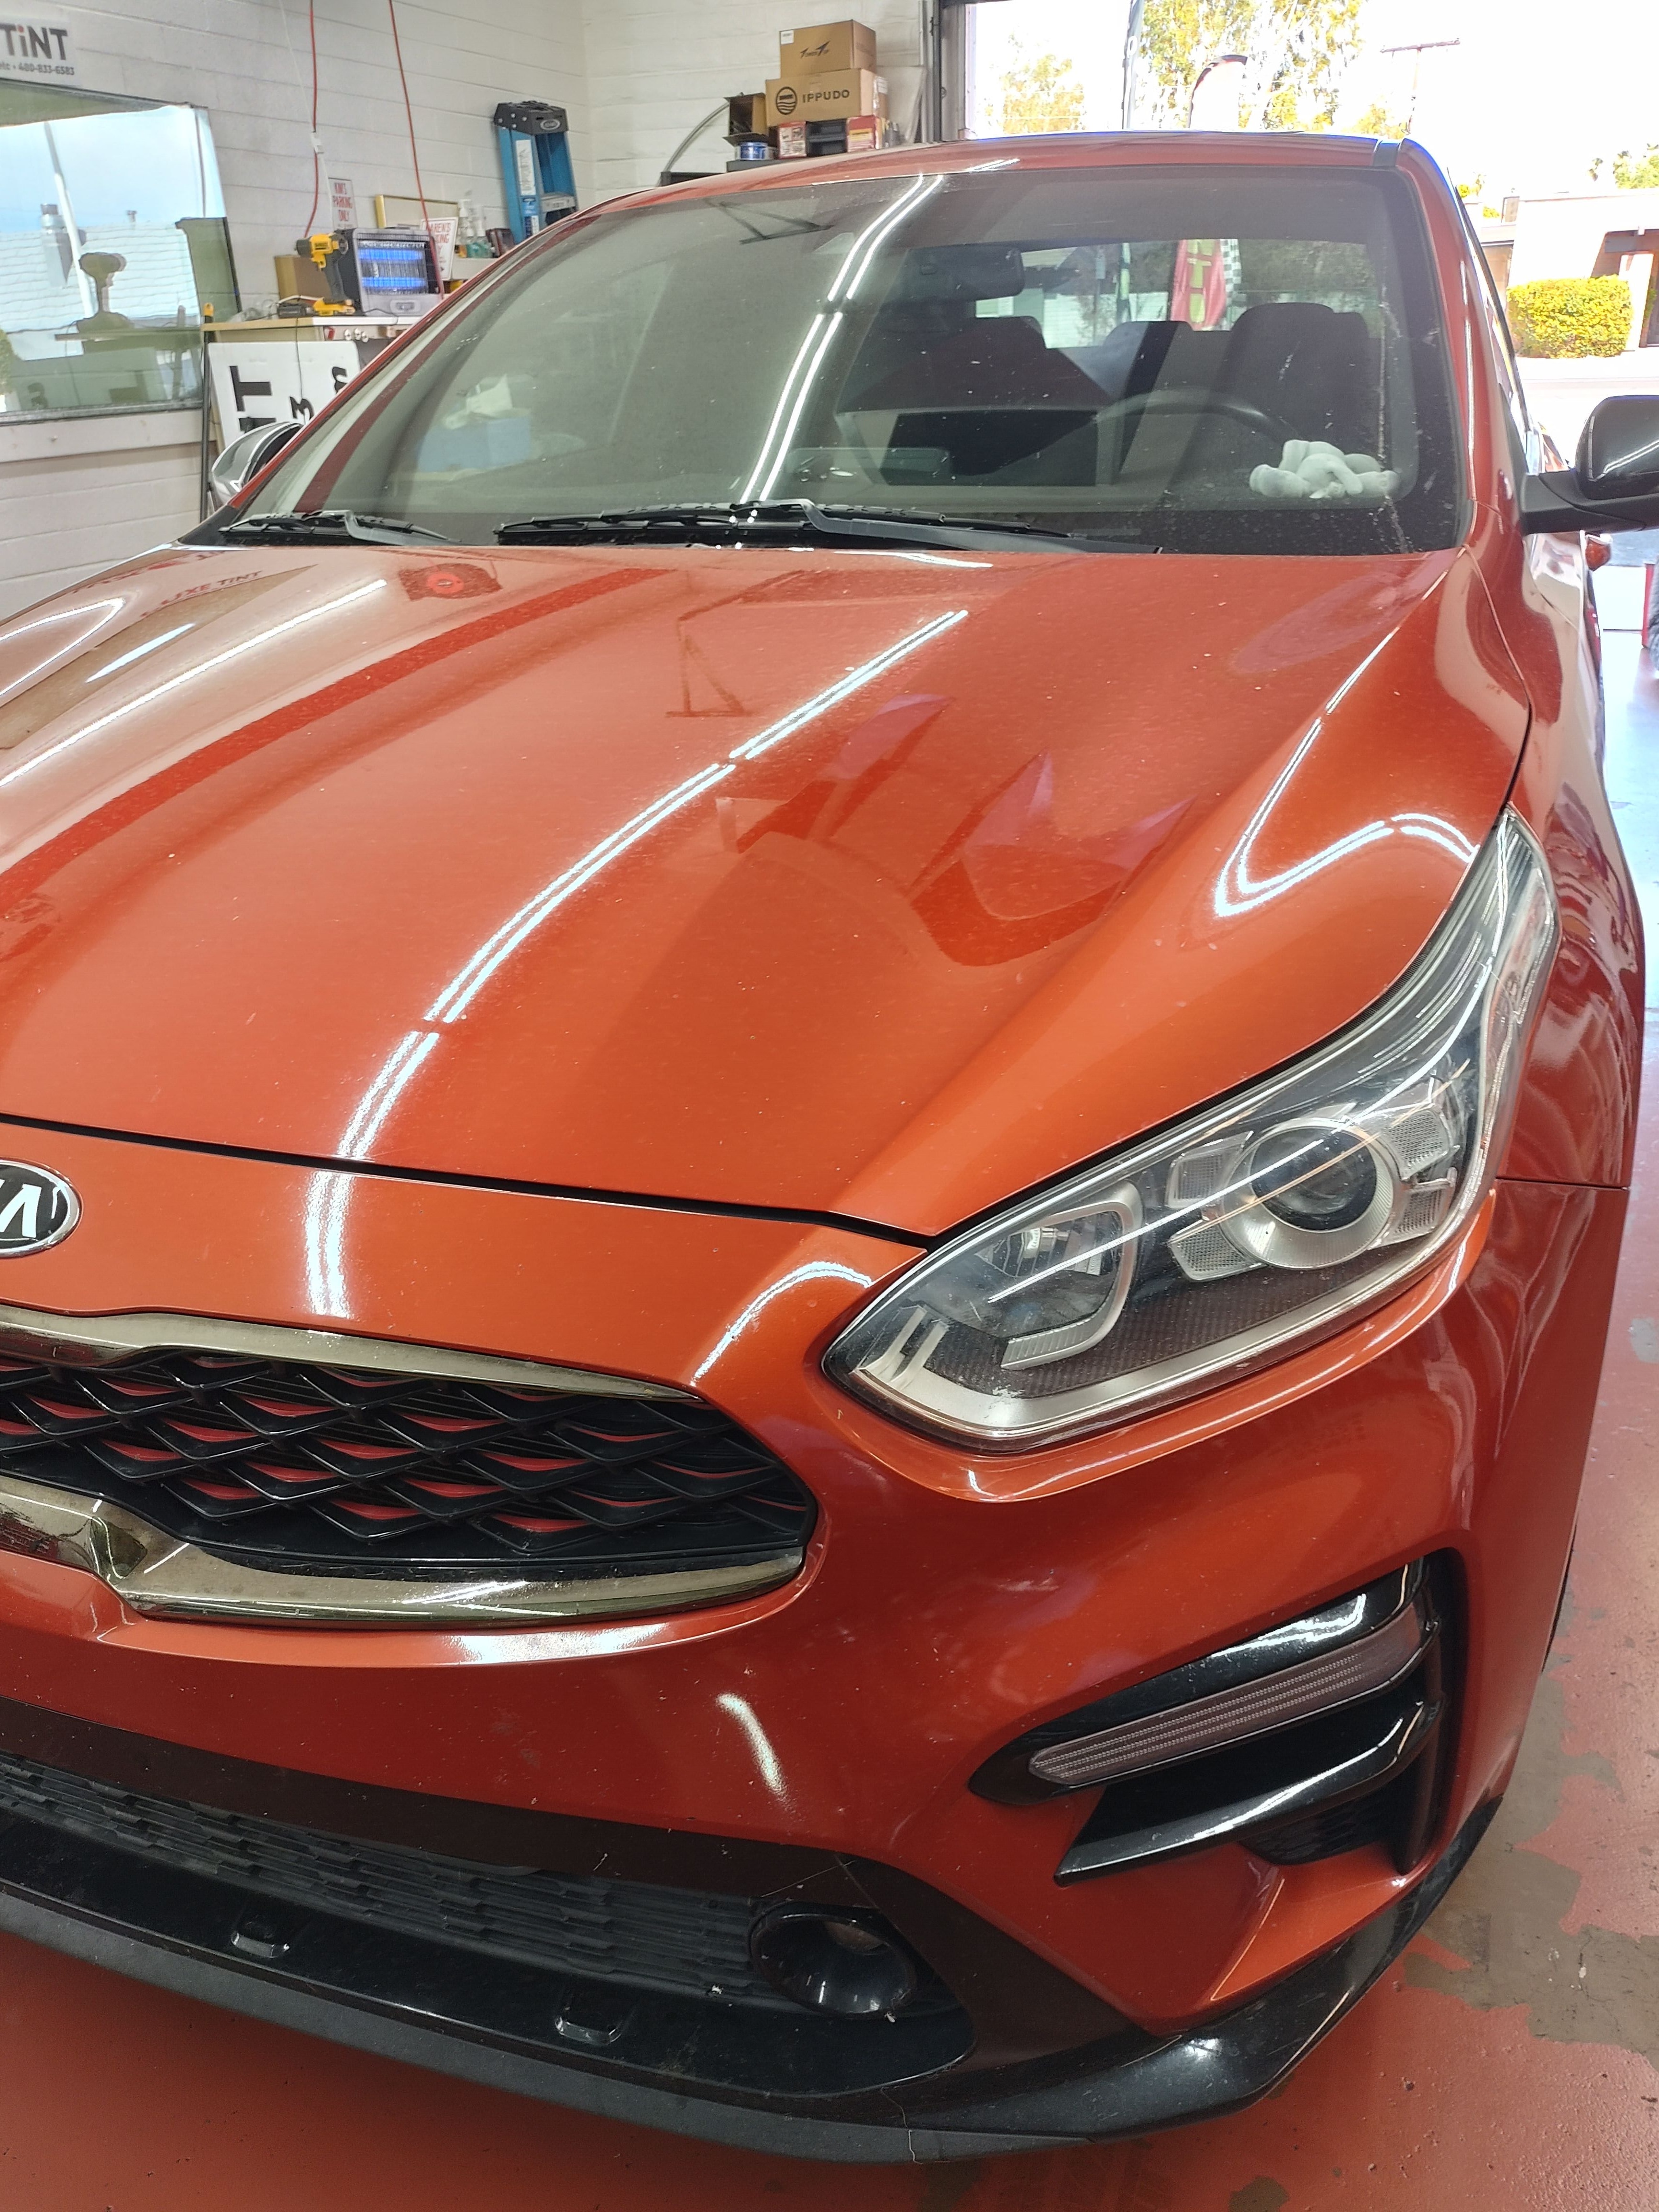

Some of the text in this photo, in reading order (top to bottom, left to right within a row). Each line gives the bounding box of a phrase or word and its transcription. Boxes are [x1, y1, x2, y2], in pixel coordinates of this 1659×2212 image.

[802, 89, 850, 103] IPPUDO
[332, 195, 353, 209] PARKING
[339, 210, 350, 221] ONLY
[430, 222, 451, 232] AREN'S
